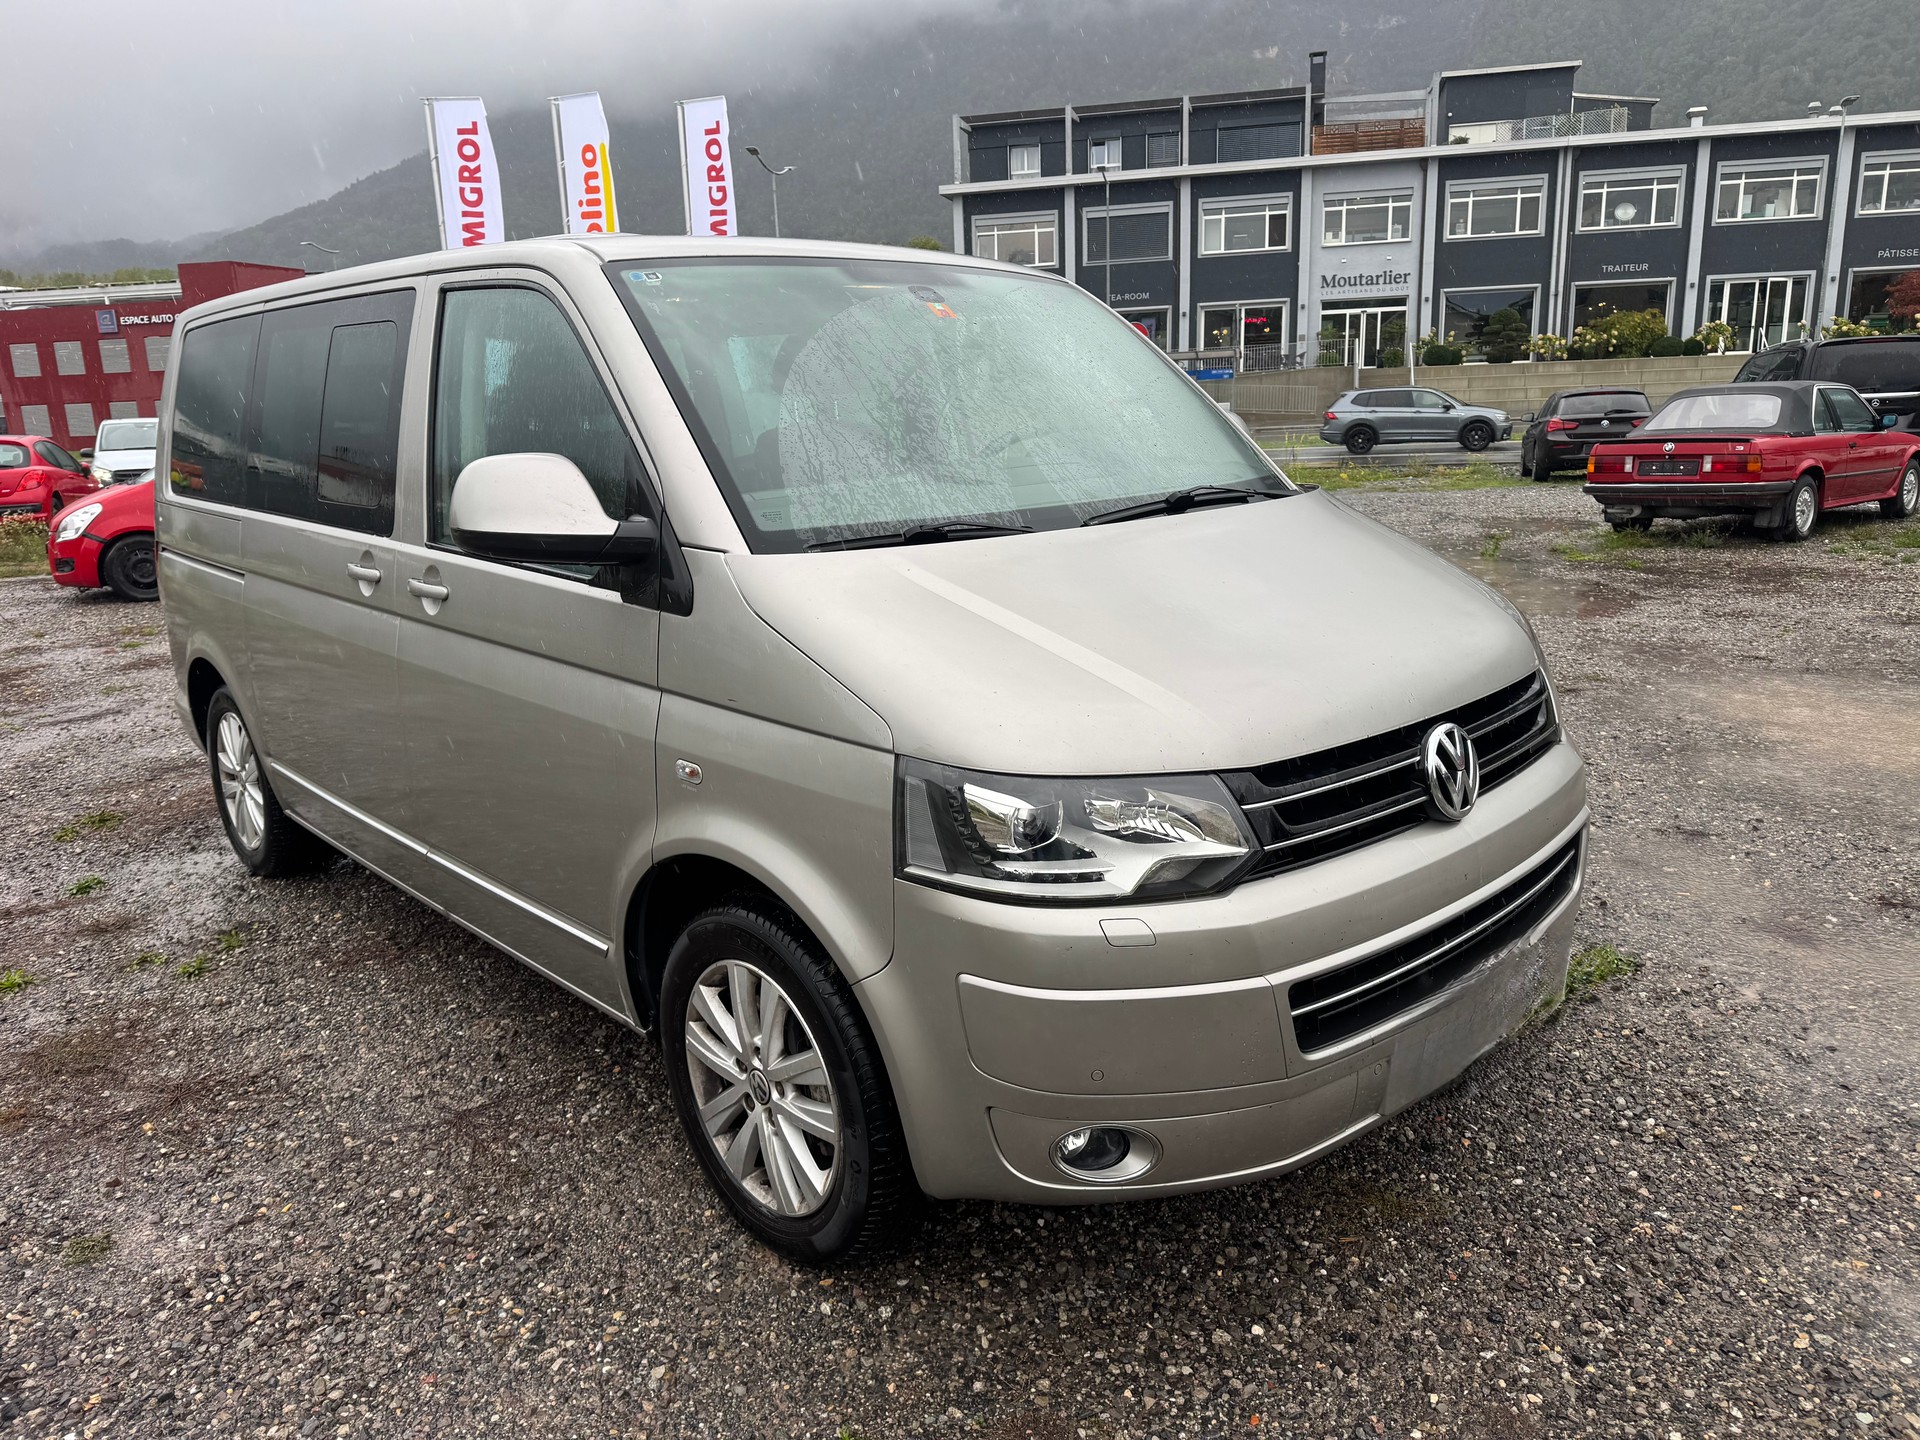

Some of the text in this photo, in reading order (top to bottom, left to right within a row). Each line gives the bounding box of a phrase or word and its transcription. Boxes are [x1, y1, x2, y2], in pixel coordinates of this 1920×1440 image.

[457, 121, 486, 247] MIGROL
[1877, 247, 1920, 258] PÂTISSE
[1601, 263, 1649, 272] TRAITEUR
[1320, 270, 1411, 288] Moutarlier
[120, 316, 149, 325] ESPACE
[151, 314, 174, 324] AUTO
